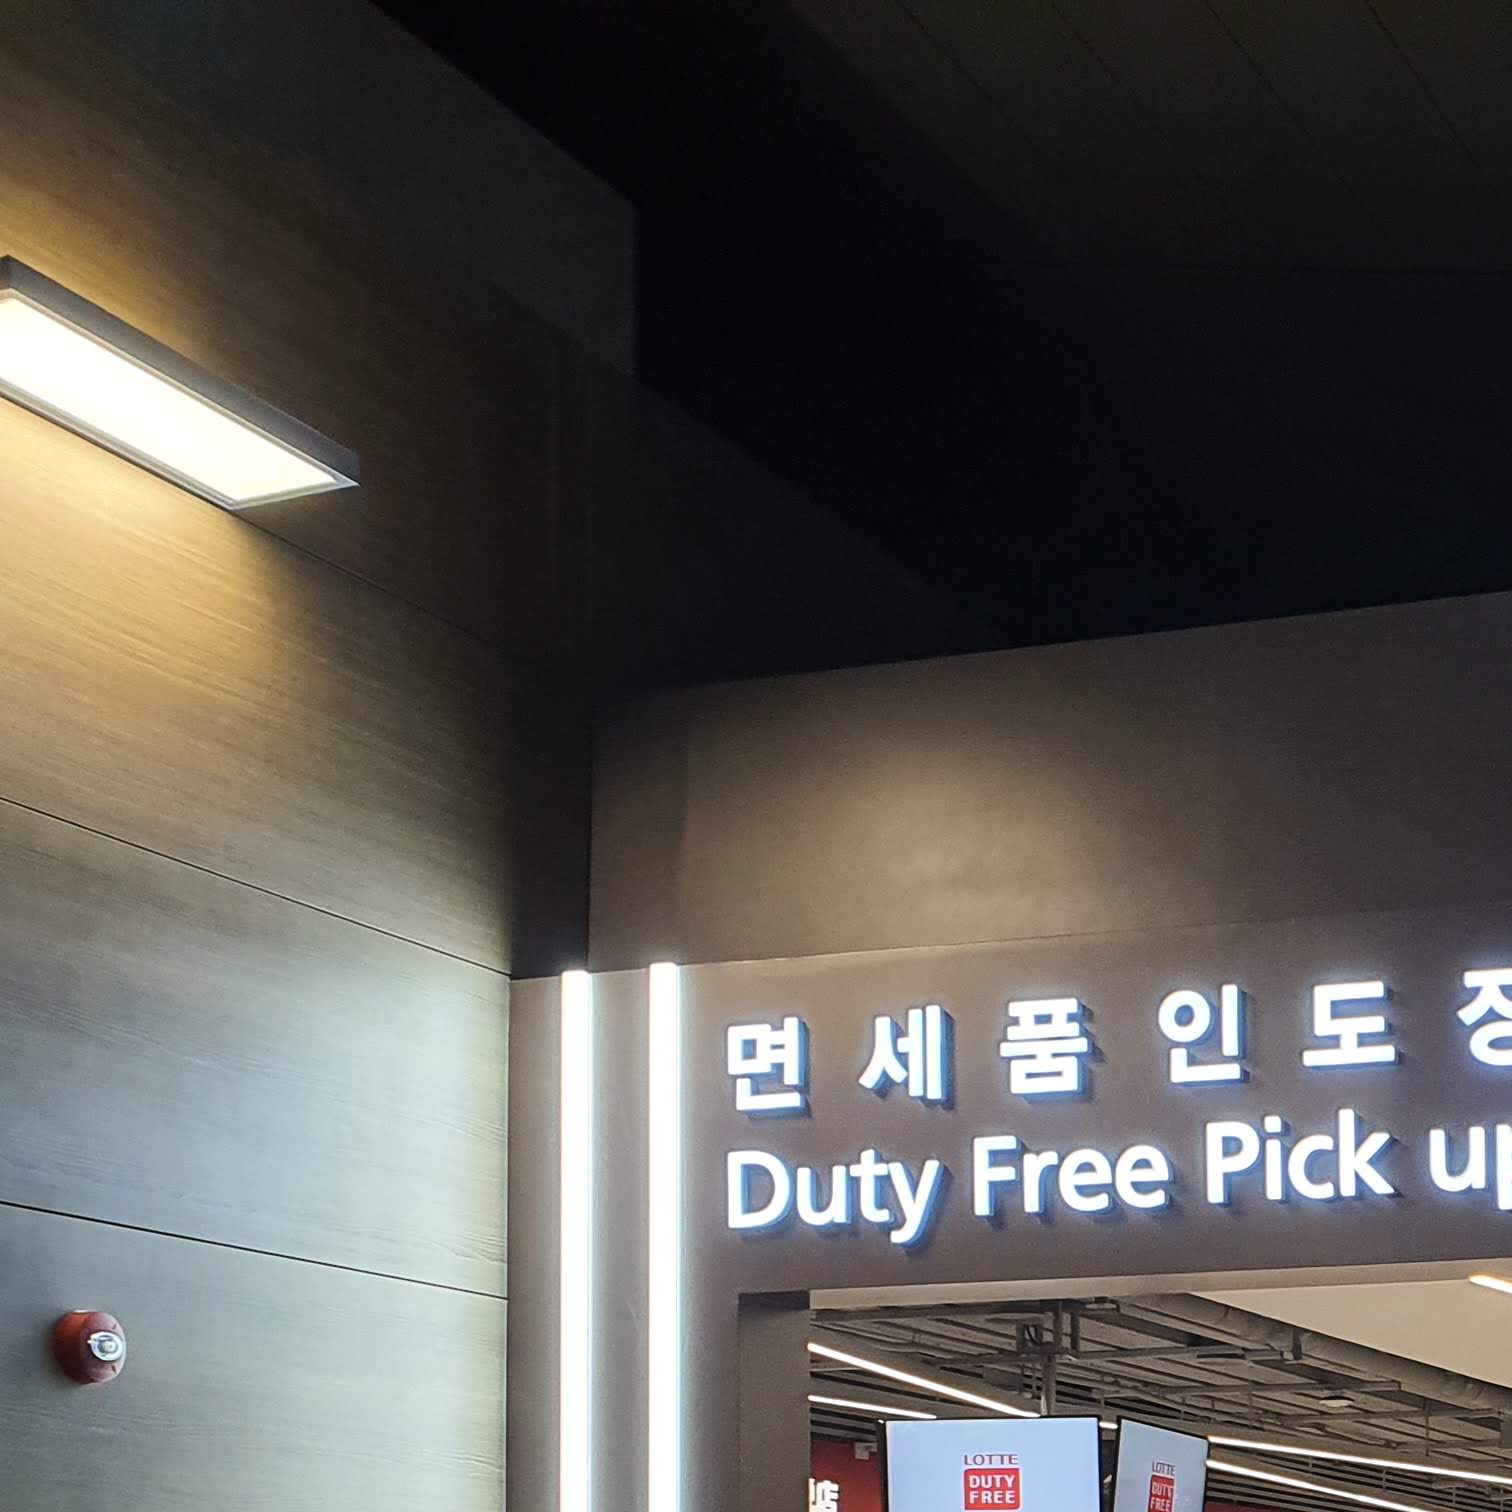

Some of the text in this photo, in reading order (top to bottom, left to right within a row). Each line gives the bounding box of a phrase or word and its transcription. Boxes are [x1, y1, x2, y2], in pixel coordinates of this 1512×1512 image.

[726, 1148, 941, 1245] Duty
[973, 1135, 1170, 1216] Free
[1206, 1108, 1395, 1204] Pick
[964, 1454, 1019, 1465] LOTTE
[1152, 1461, 1176, 1476] LOTTE
[969, 1474, 1016, 1488] DUTY
[969, 1490, 1016, 1504] FREE
[1152, 1482, 1174, 1497] DUTY
[1150, 1497, 1171, 1512] FREE
